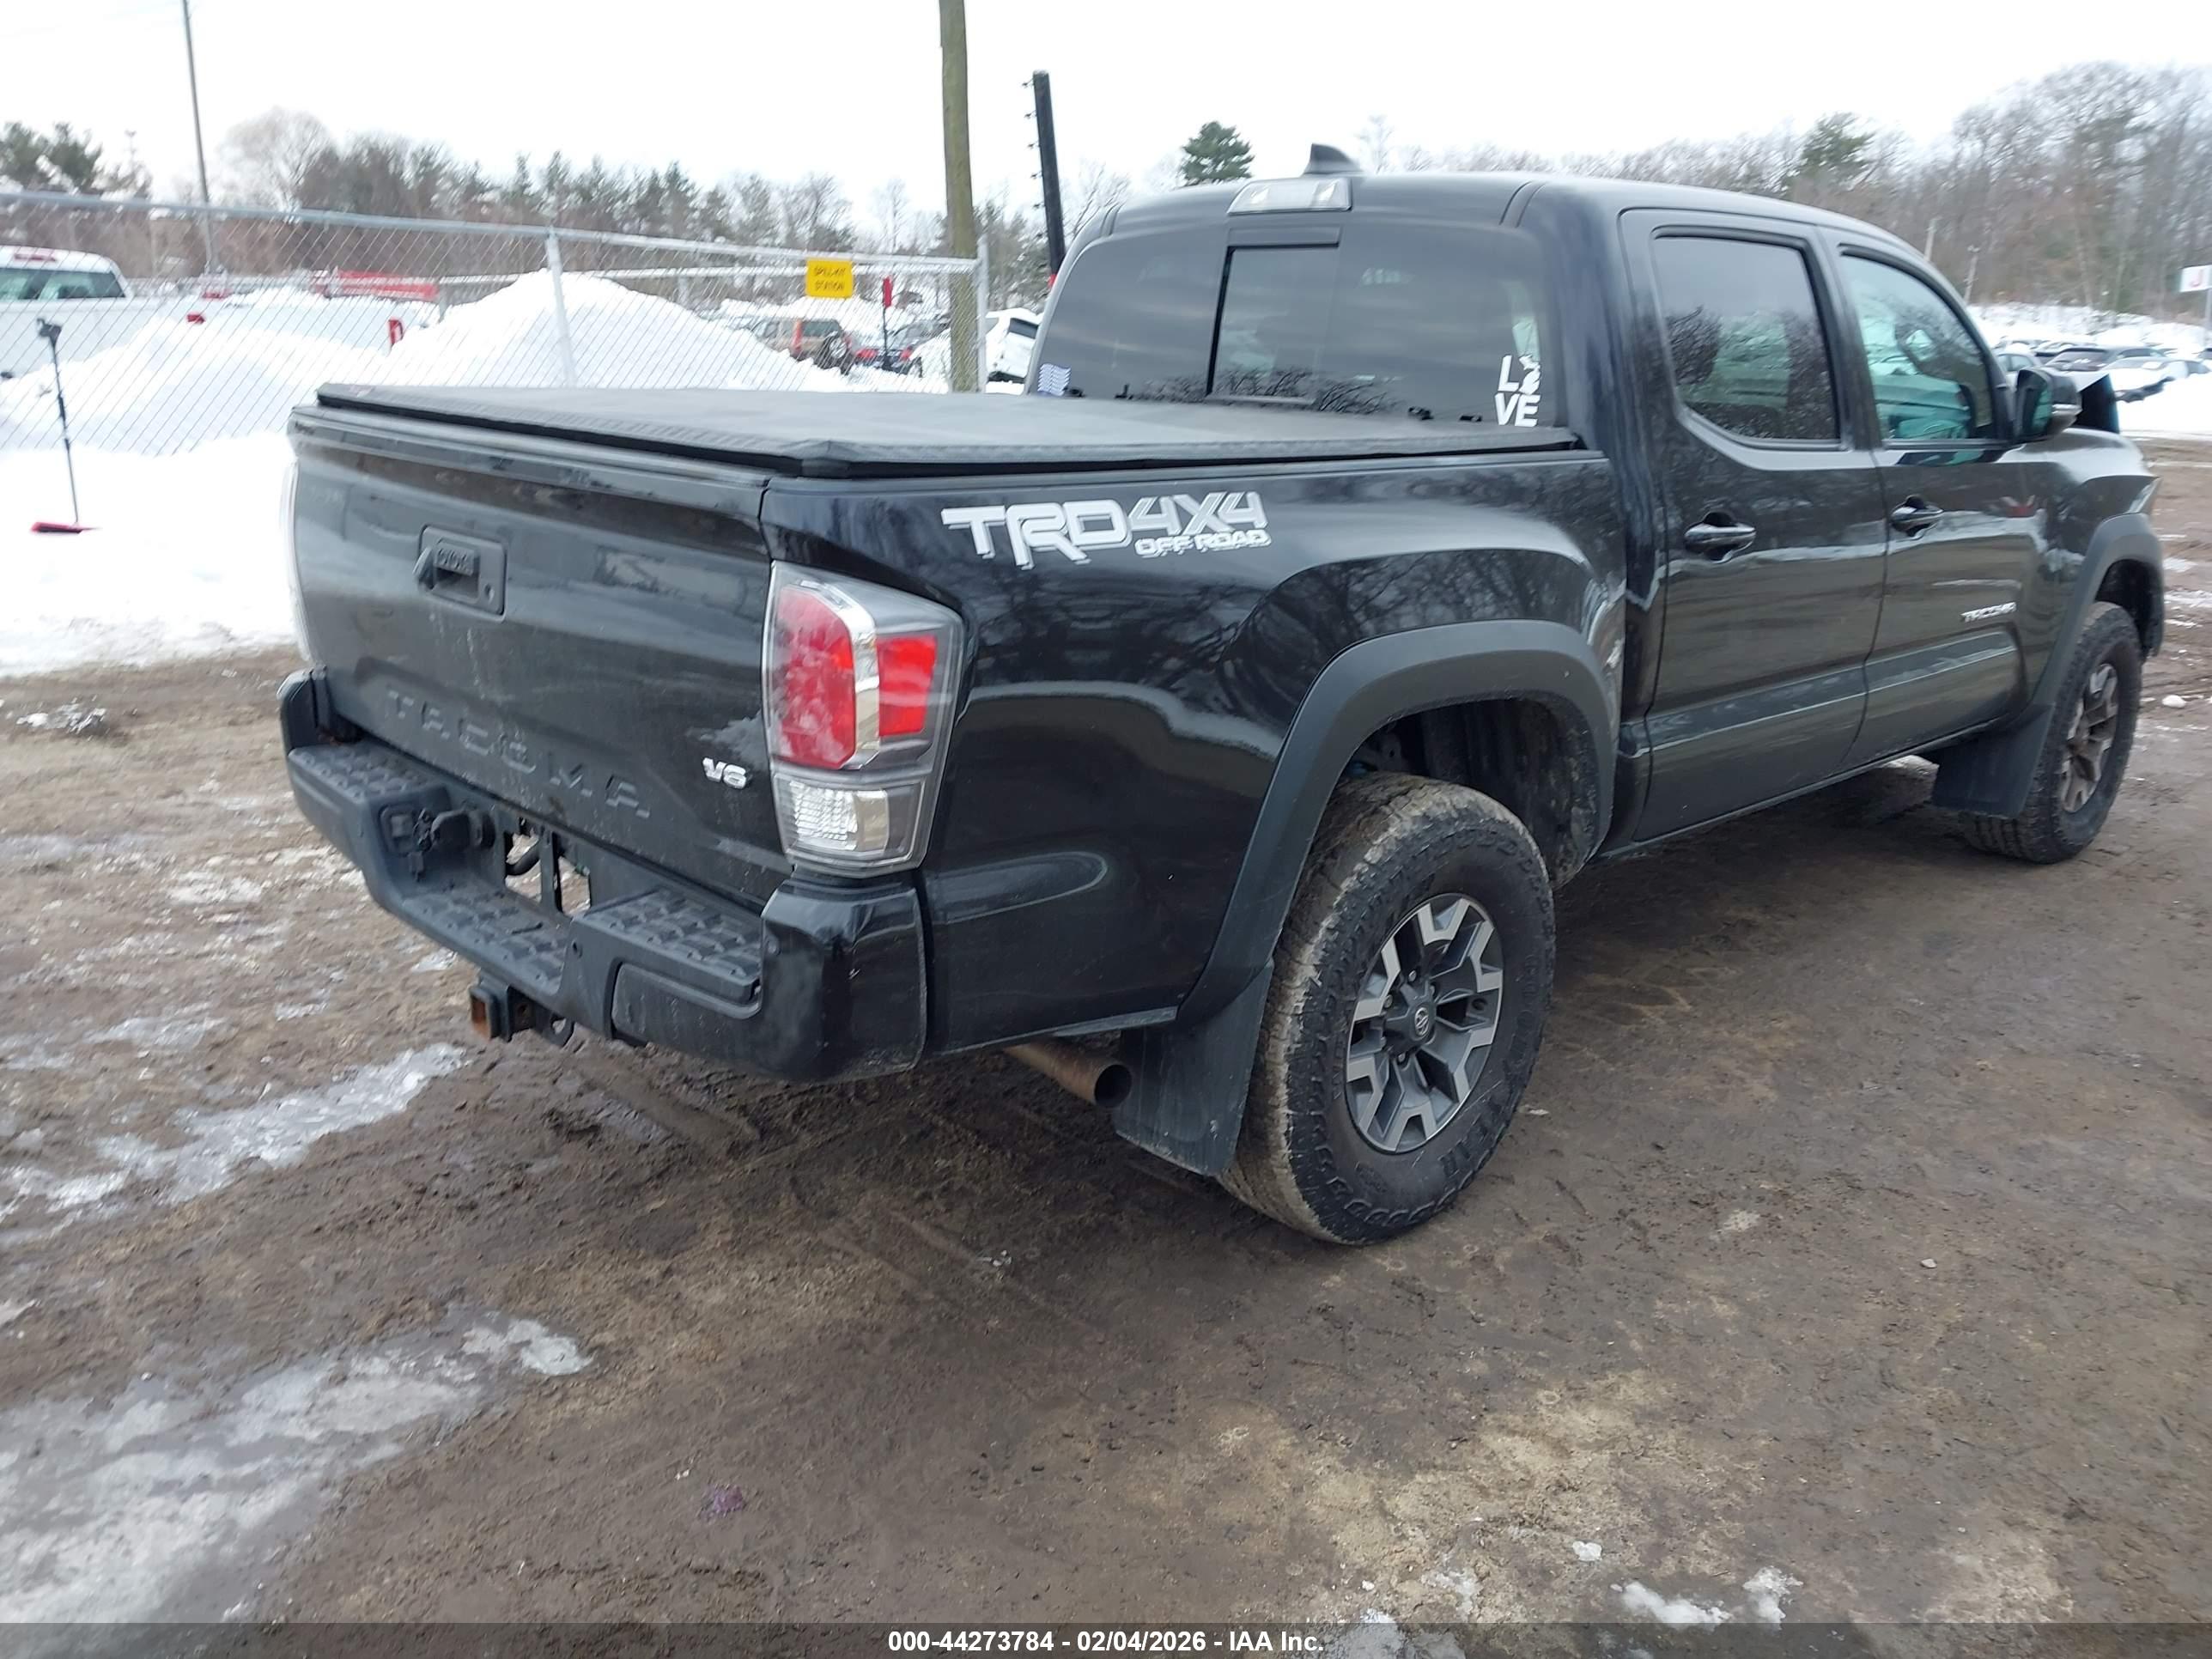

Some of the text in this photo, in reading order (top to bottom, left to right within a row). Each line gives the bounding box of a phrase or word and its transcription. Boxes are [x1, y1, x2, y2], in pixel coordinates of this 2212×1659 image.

[941, 491, 1268, 570] TRD 4X4
[1134, 529, 1272, 558] OFF ROAD
[702, 757, 747, 789] V6
